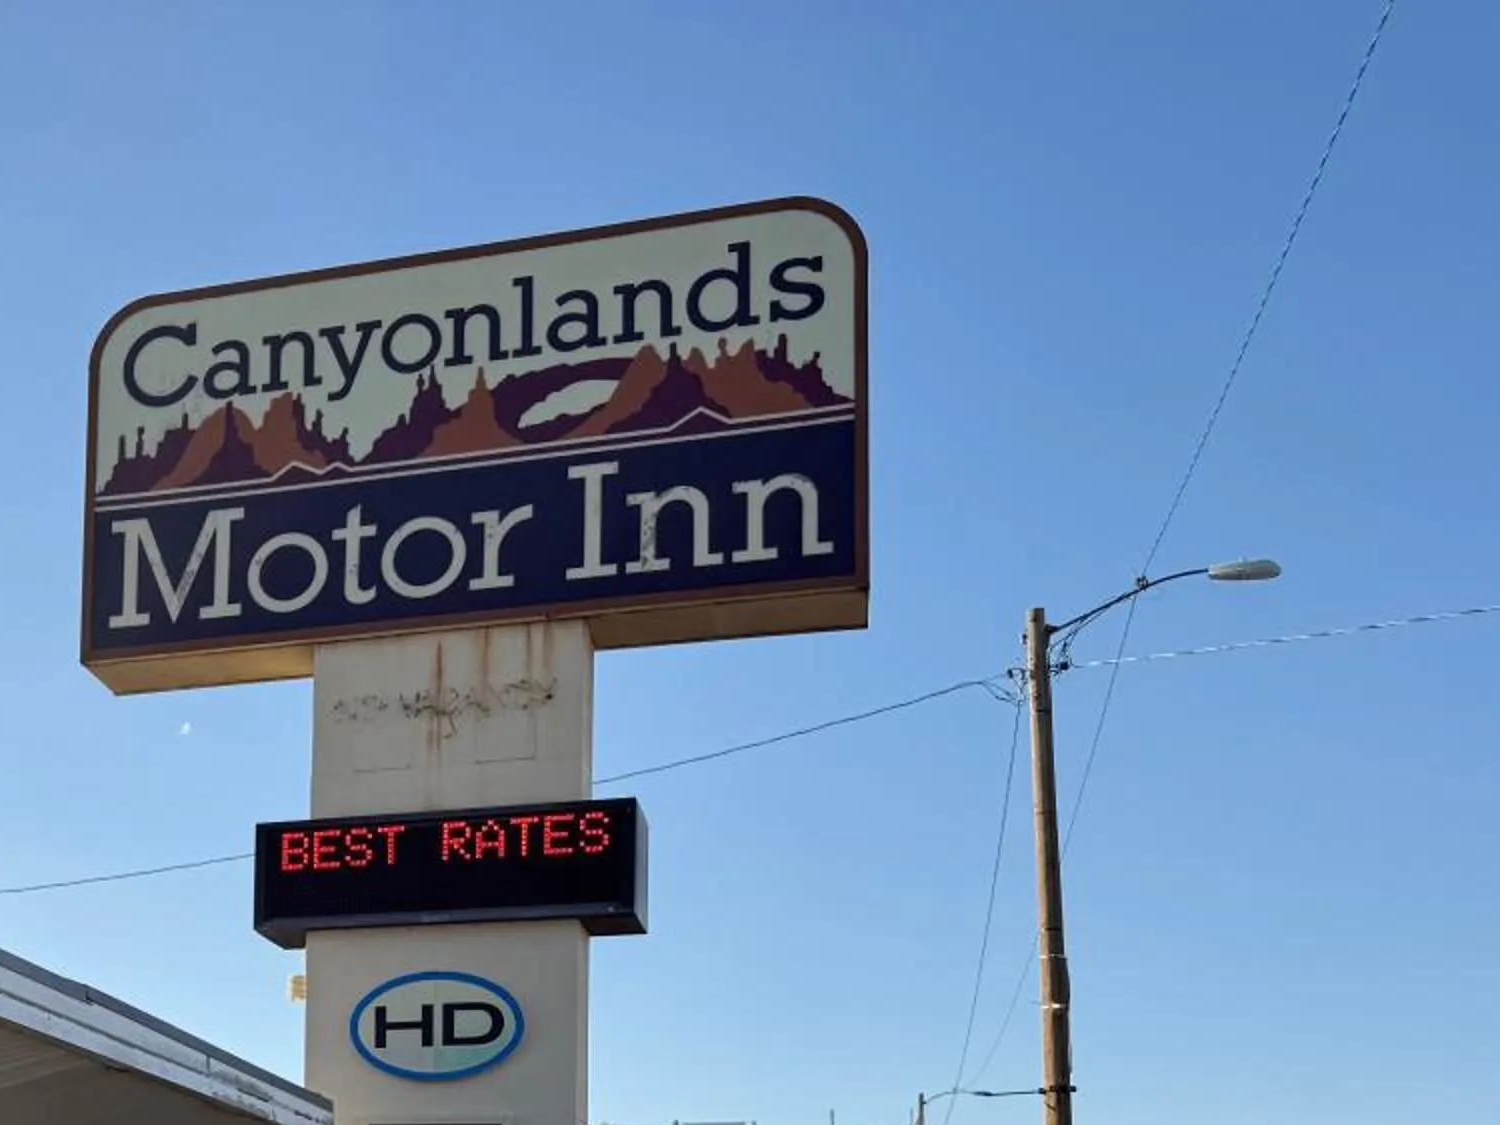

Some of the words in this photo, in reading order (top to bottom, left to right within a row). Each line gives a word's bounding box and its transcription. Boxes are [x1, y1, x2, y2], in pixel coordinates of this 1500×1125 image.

[123, 241, 826, 408] Canyonlands
[108, 503, 534, 630] Motor
[566, 461, 835, 581] Inn
[280, 825, 405, 871] BEST
[441, 811, 612, 861] RATES
[374, 1001, 505, 1049] HD
